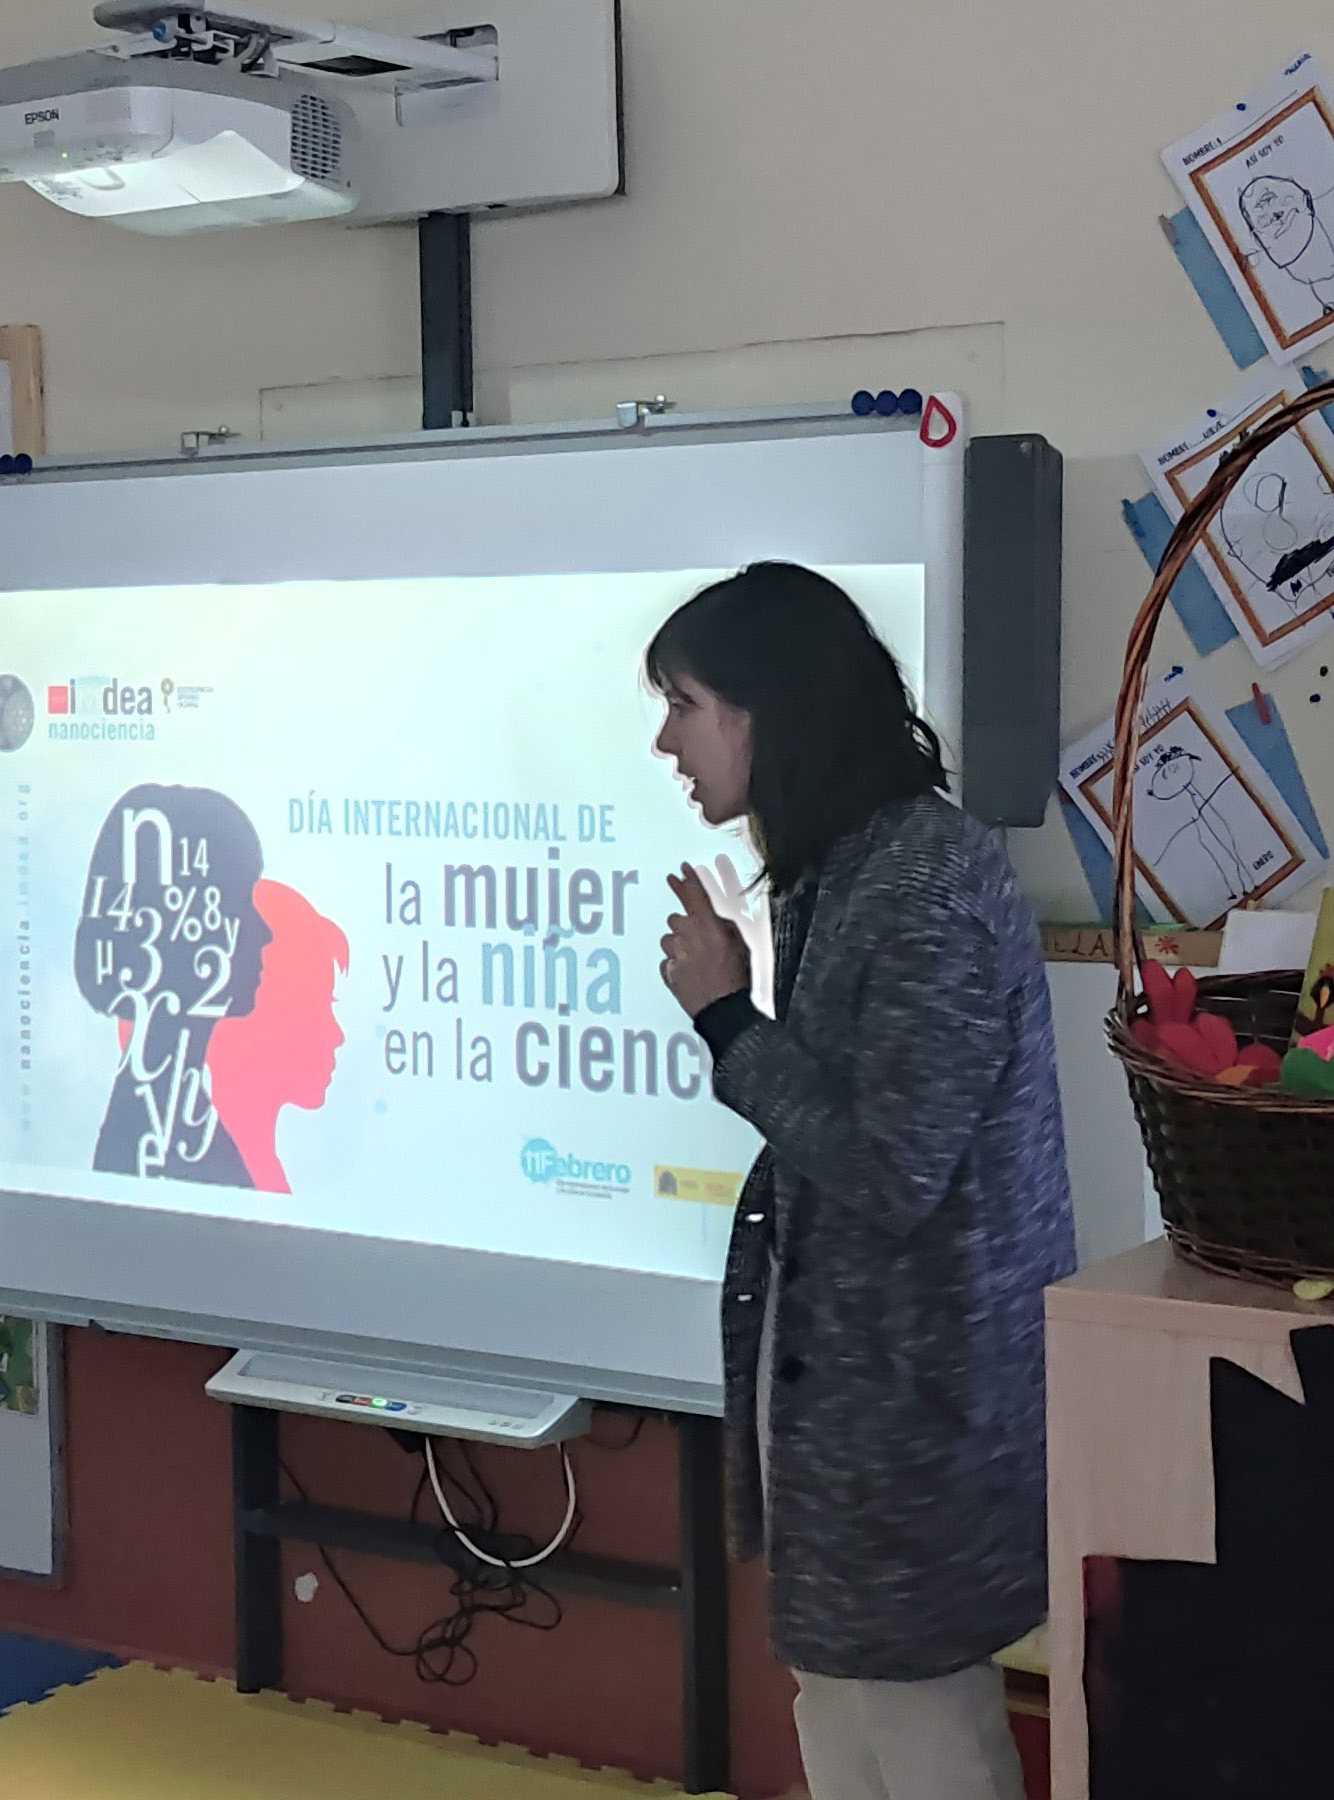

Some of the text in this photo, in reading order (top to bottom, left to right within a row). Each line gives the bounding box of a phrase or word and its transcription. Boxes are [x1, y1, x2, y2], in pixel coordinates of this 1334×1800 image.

[25, 109, 59, 125] EPSON
[1258, 144, 1273, 158] SOY
[48, 717, 156, 741] nanociencia
[288, 789, 616, 843] DÍA INTERNACIONAL DE
[385, 846, 639, 948] la mujer
[382, 922, 622, 1016] y la niña
[385, 1027, 434, 1077] en
[455, 1017, 492, 1083] la
